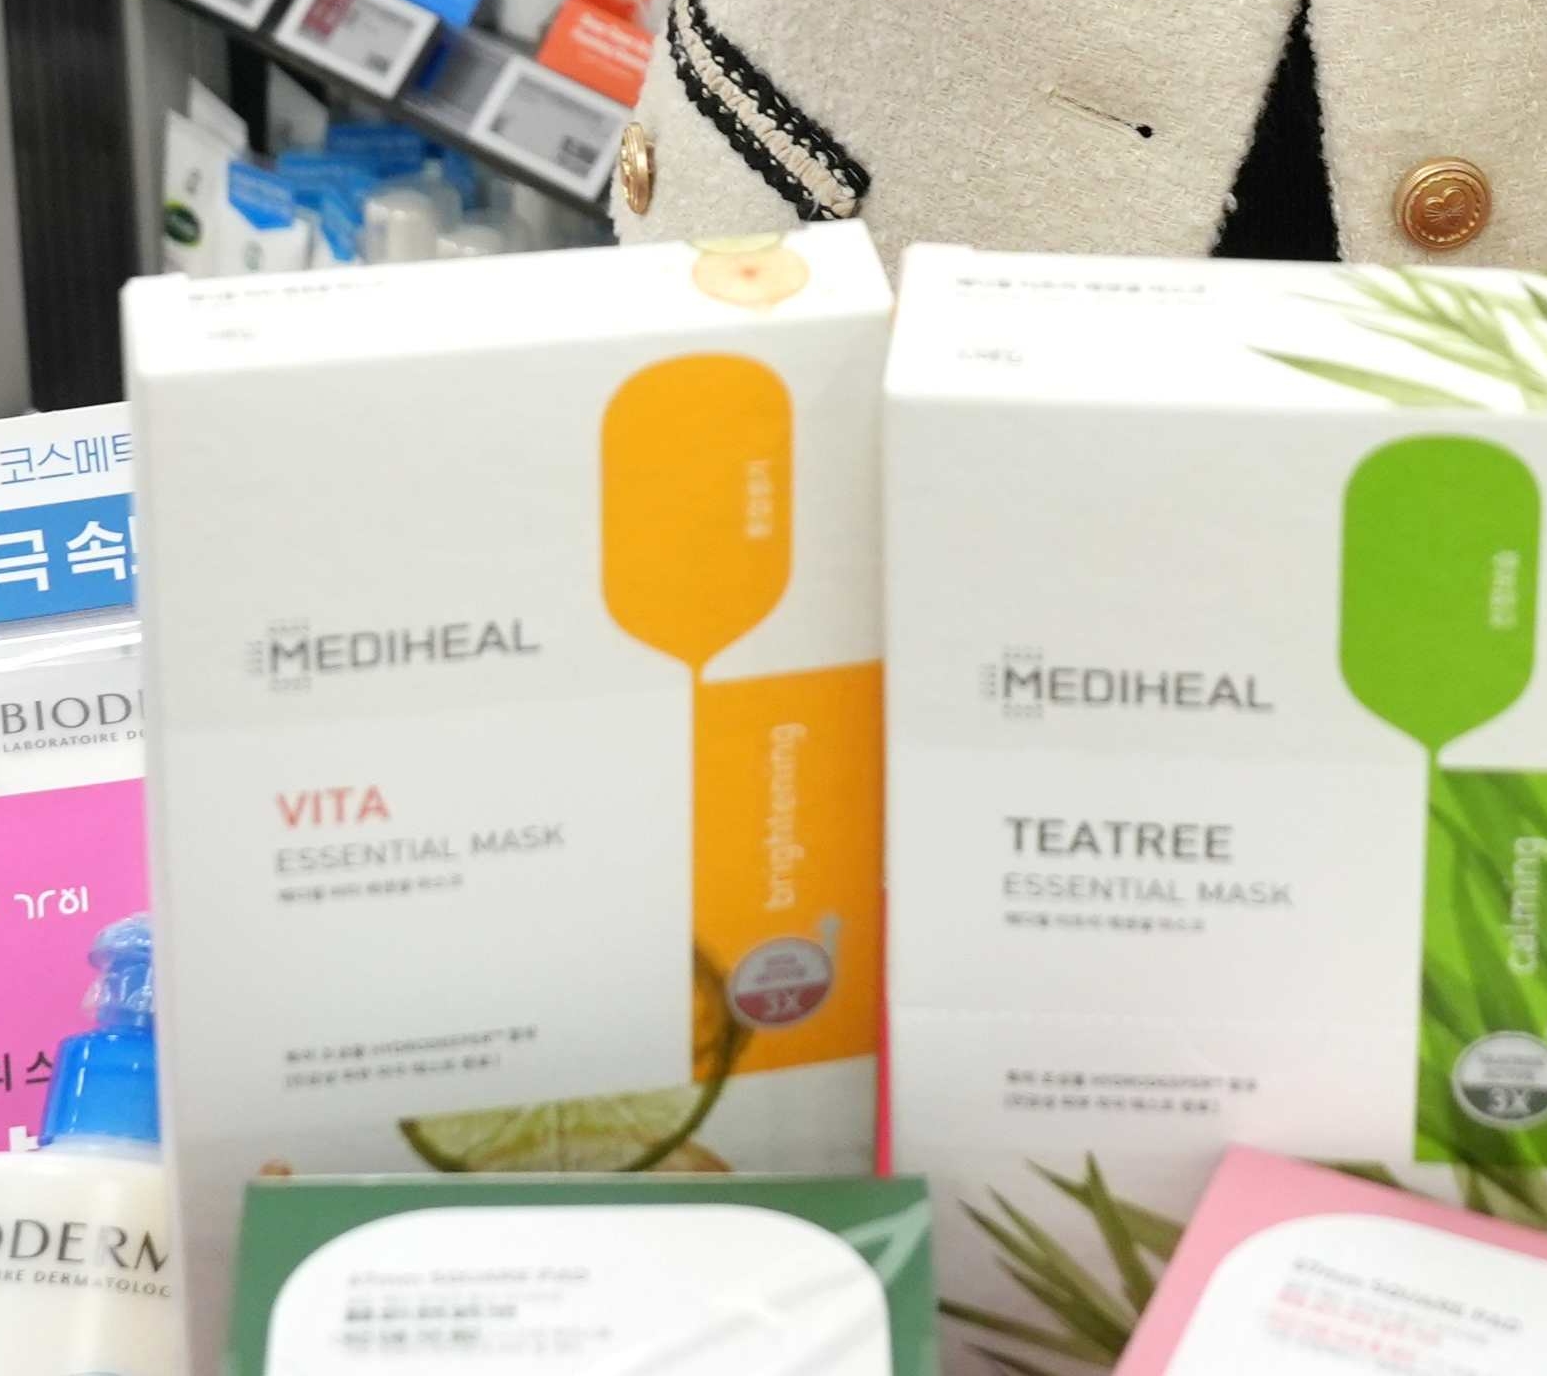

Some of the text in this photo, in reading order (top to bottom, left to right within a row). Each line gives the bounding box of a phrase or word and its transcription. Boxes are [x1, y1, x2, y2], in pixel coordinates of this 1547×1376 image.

[268, 617, 541, 677] MEDIHEAL
[1003, 661, 1276, 714] MEDIHEAL
[275, 784, 392, 830] VITA
[275, 821, 565, 876] ESSENTIAL MASK
[1005, 816, 1233, 863] TEATREE
[1003, 872, 1294, 909] ESSENTIAL MASK
